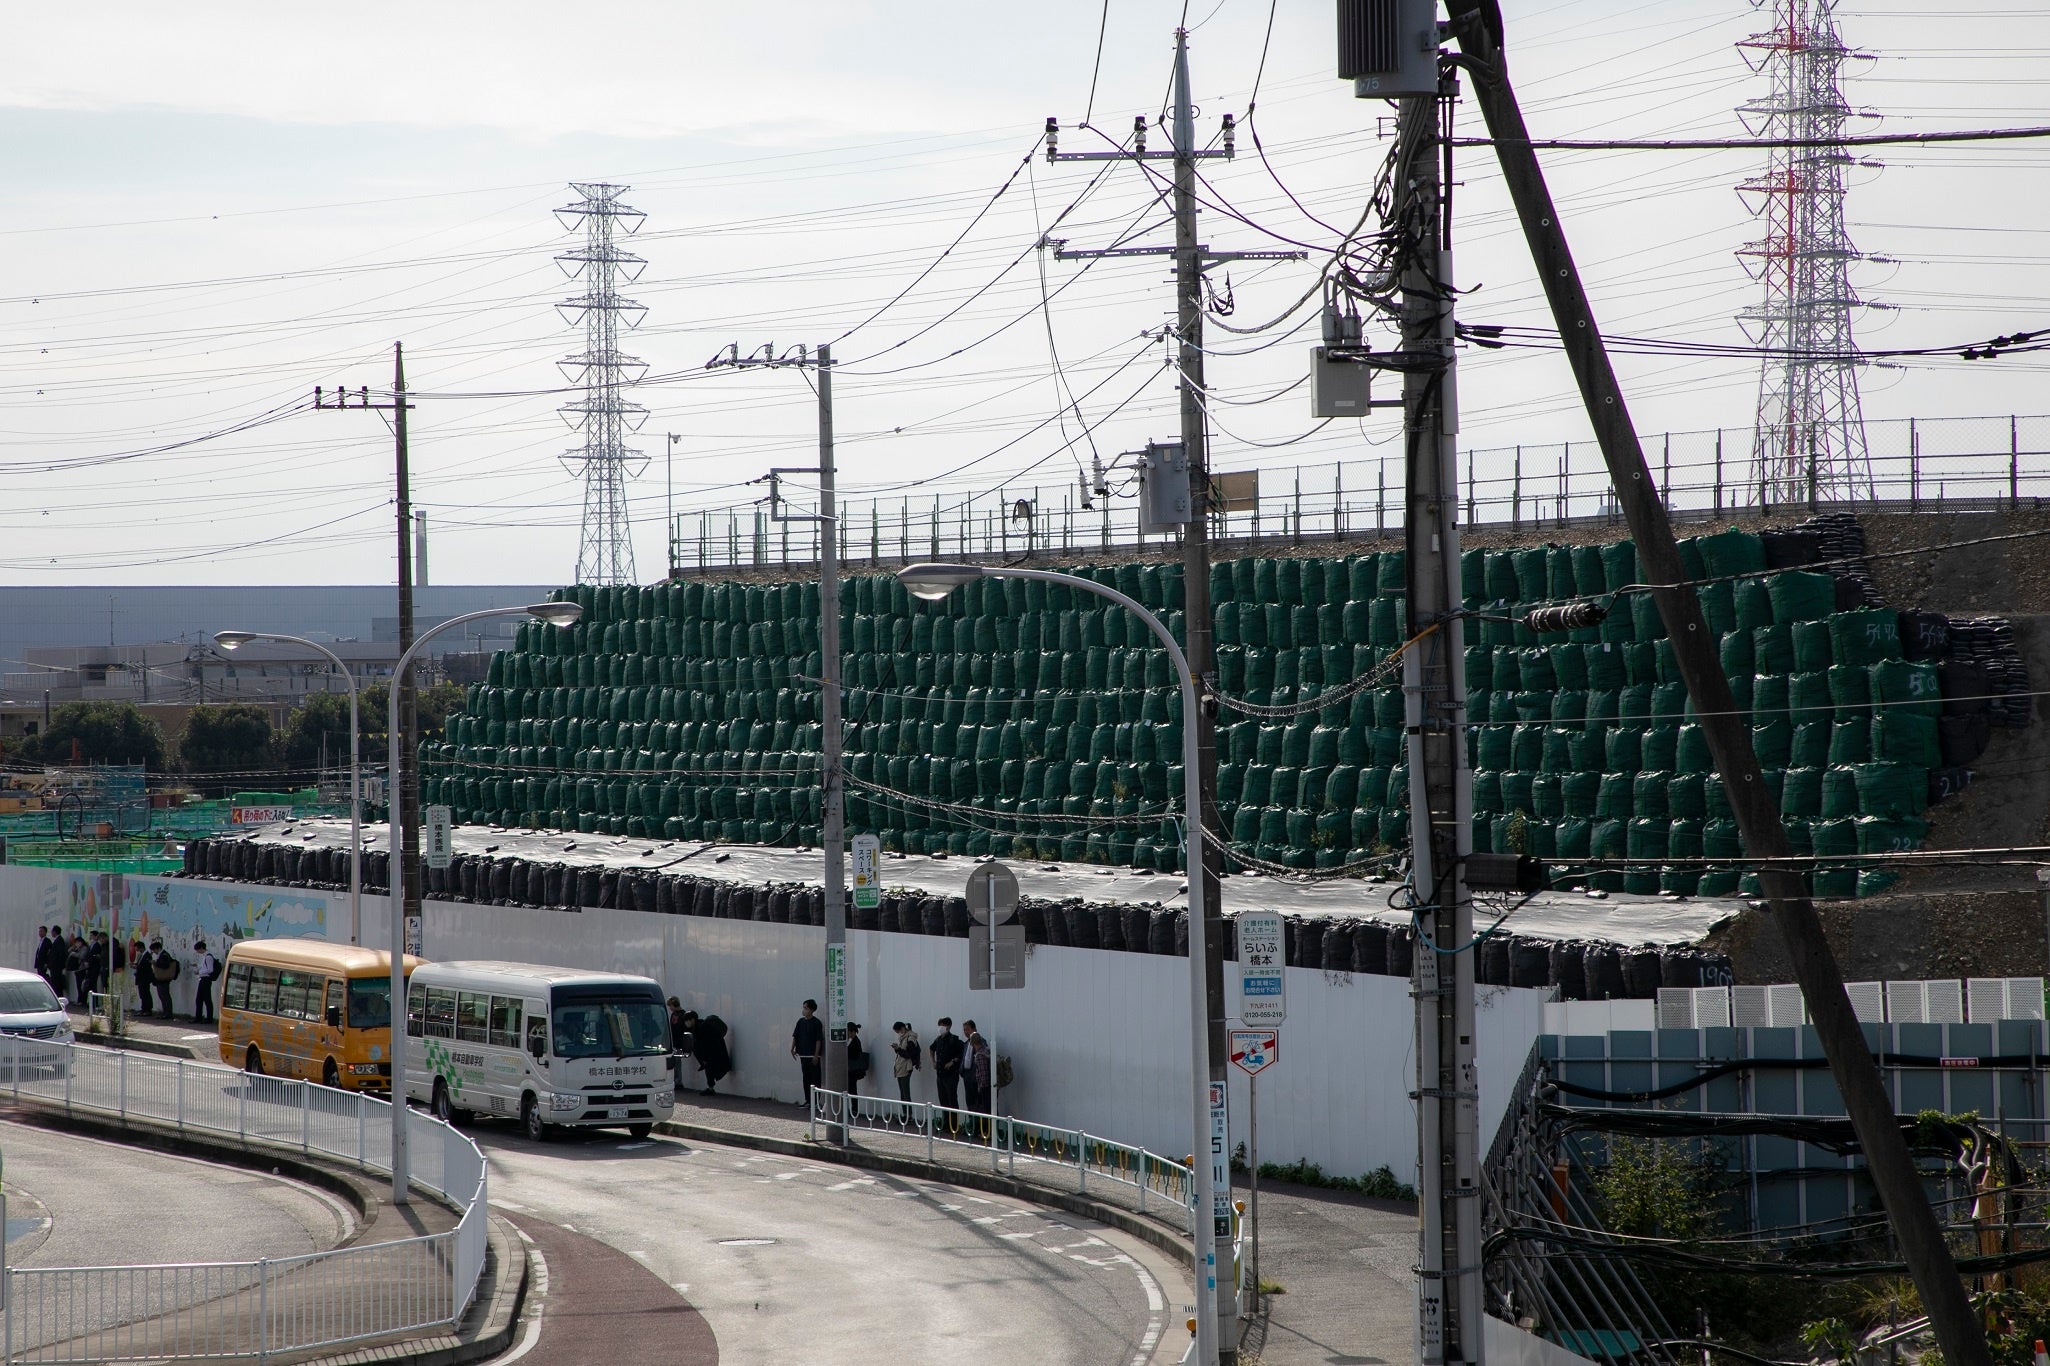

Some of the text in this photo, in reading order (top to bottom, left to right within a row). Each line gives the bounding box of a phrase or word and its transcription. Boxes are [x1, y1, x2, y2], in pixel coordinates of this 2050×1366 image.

[1245, 943, 1278, 953] らいふ
[1250, 955, 1273, 966] 橋本
[589, 1066, 647, 1077] 橋本自動車学校
